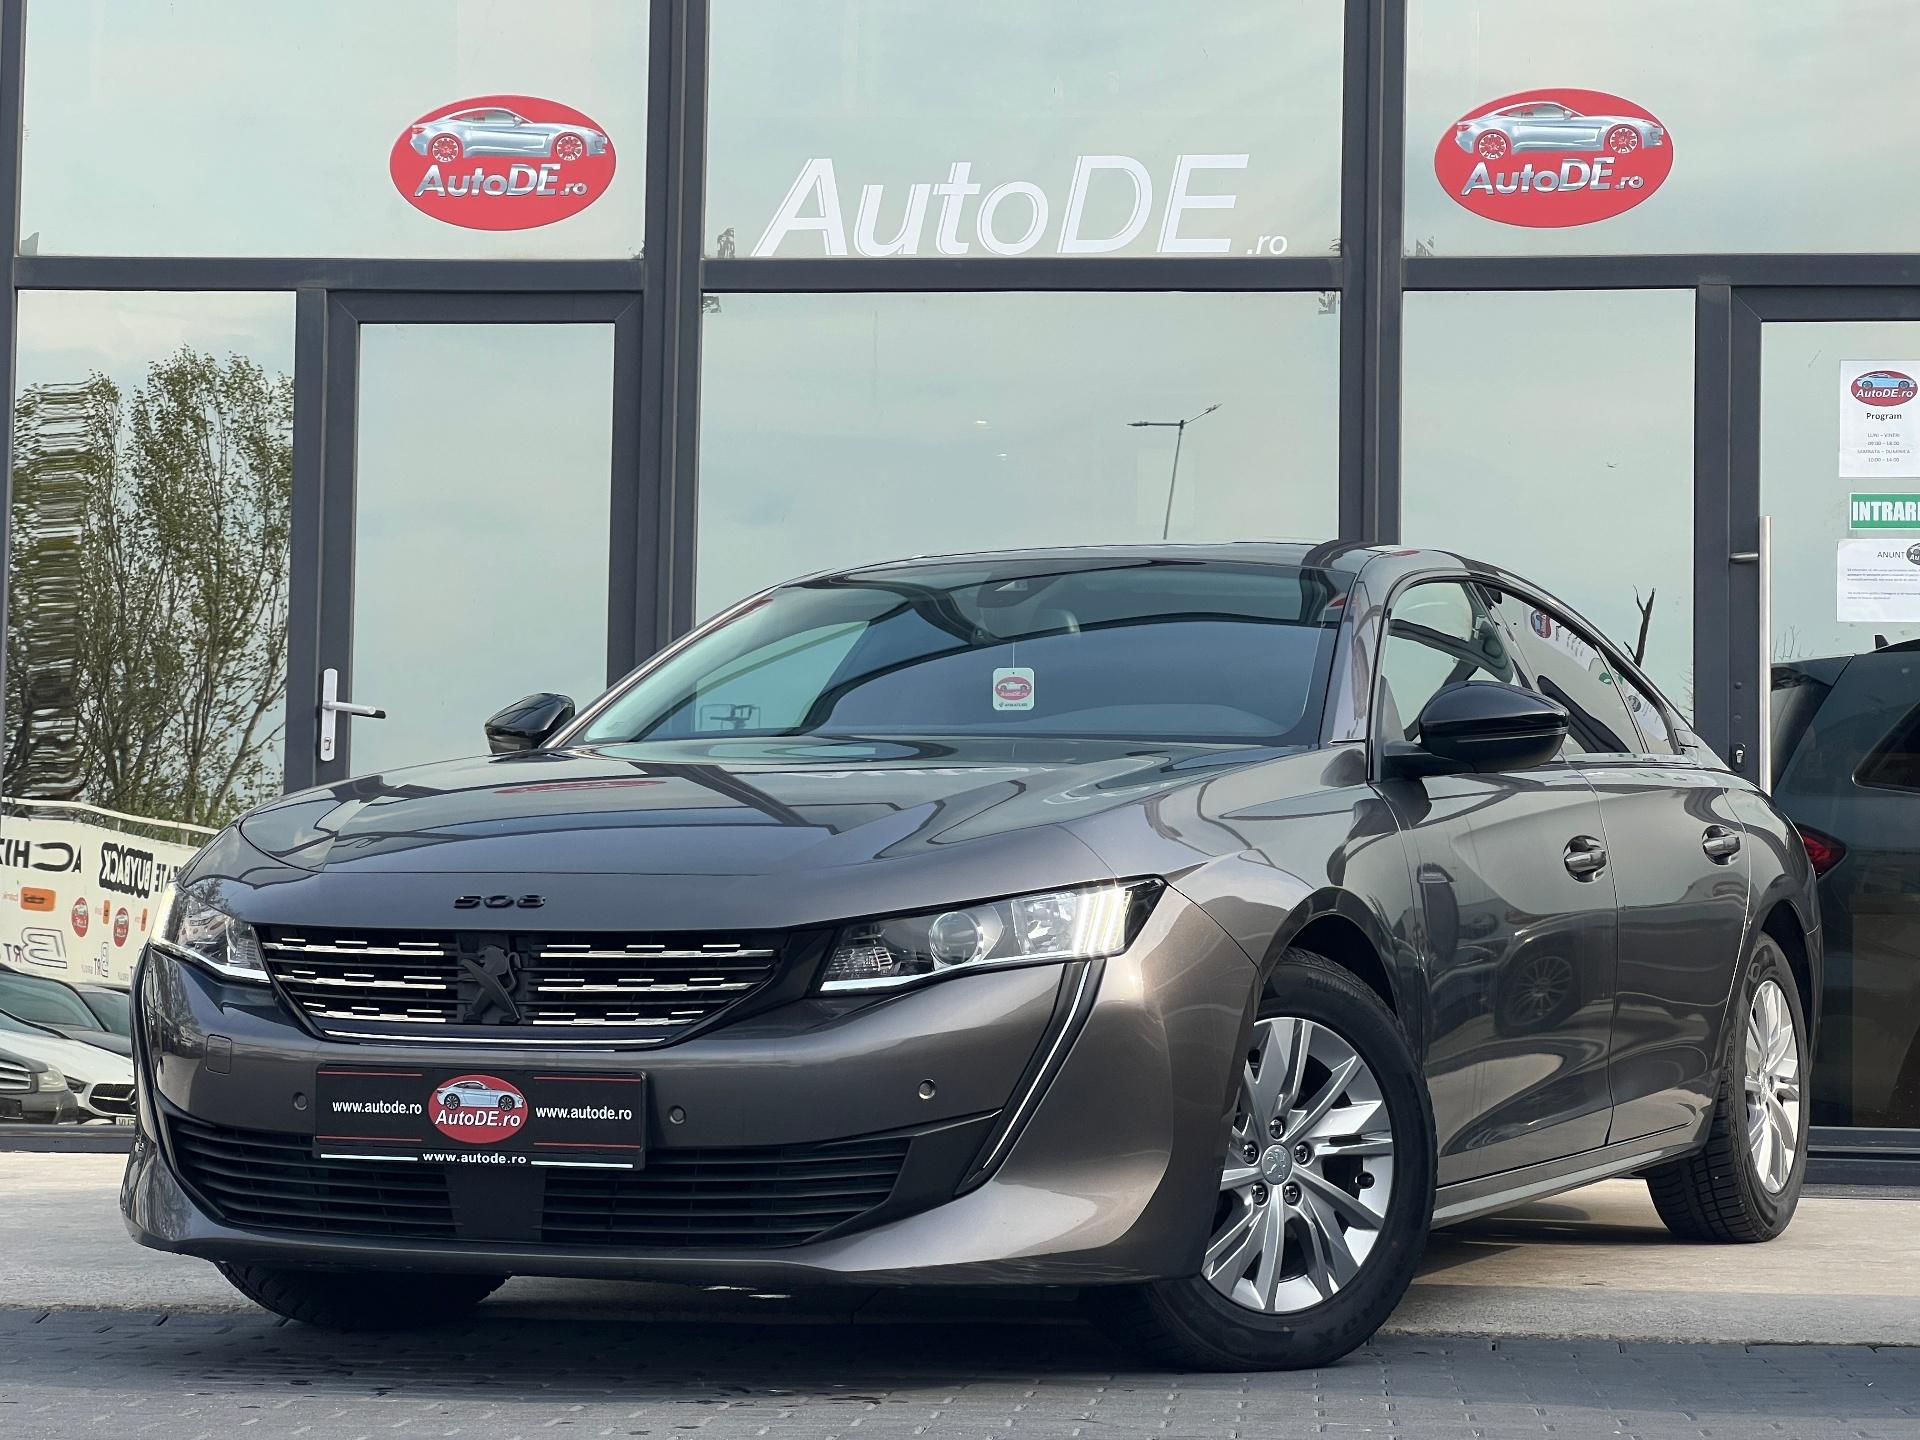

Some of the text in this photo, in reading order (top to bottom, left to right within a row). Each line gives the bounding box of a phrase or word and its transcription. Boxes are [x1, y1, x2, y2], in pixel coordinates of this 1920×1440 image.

[414, 163, 589, 197] AutoDE.ro
[1460, 156, 1645, 196] AutoDE.ro
[750, 154, 1288, 257] AutoDE.ro
[1856, 387, 1914, 399] AutoDE.ro
[1866, 412, 1902, 421] Program
[1853, 501, 1920, 521] INTRAR
[454, 894, 546, 909] 508
[332, 1099, 422, 1115] www.autode.ro
[535, 1104, 632, 1120] www.autode.ro
[435, 1109, 521, 1127] AutoDE.ro
[422, 1151, 527, 1164] www.autode.ro
